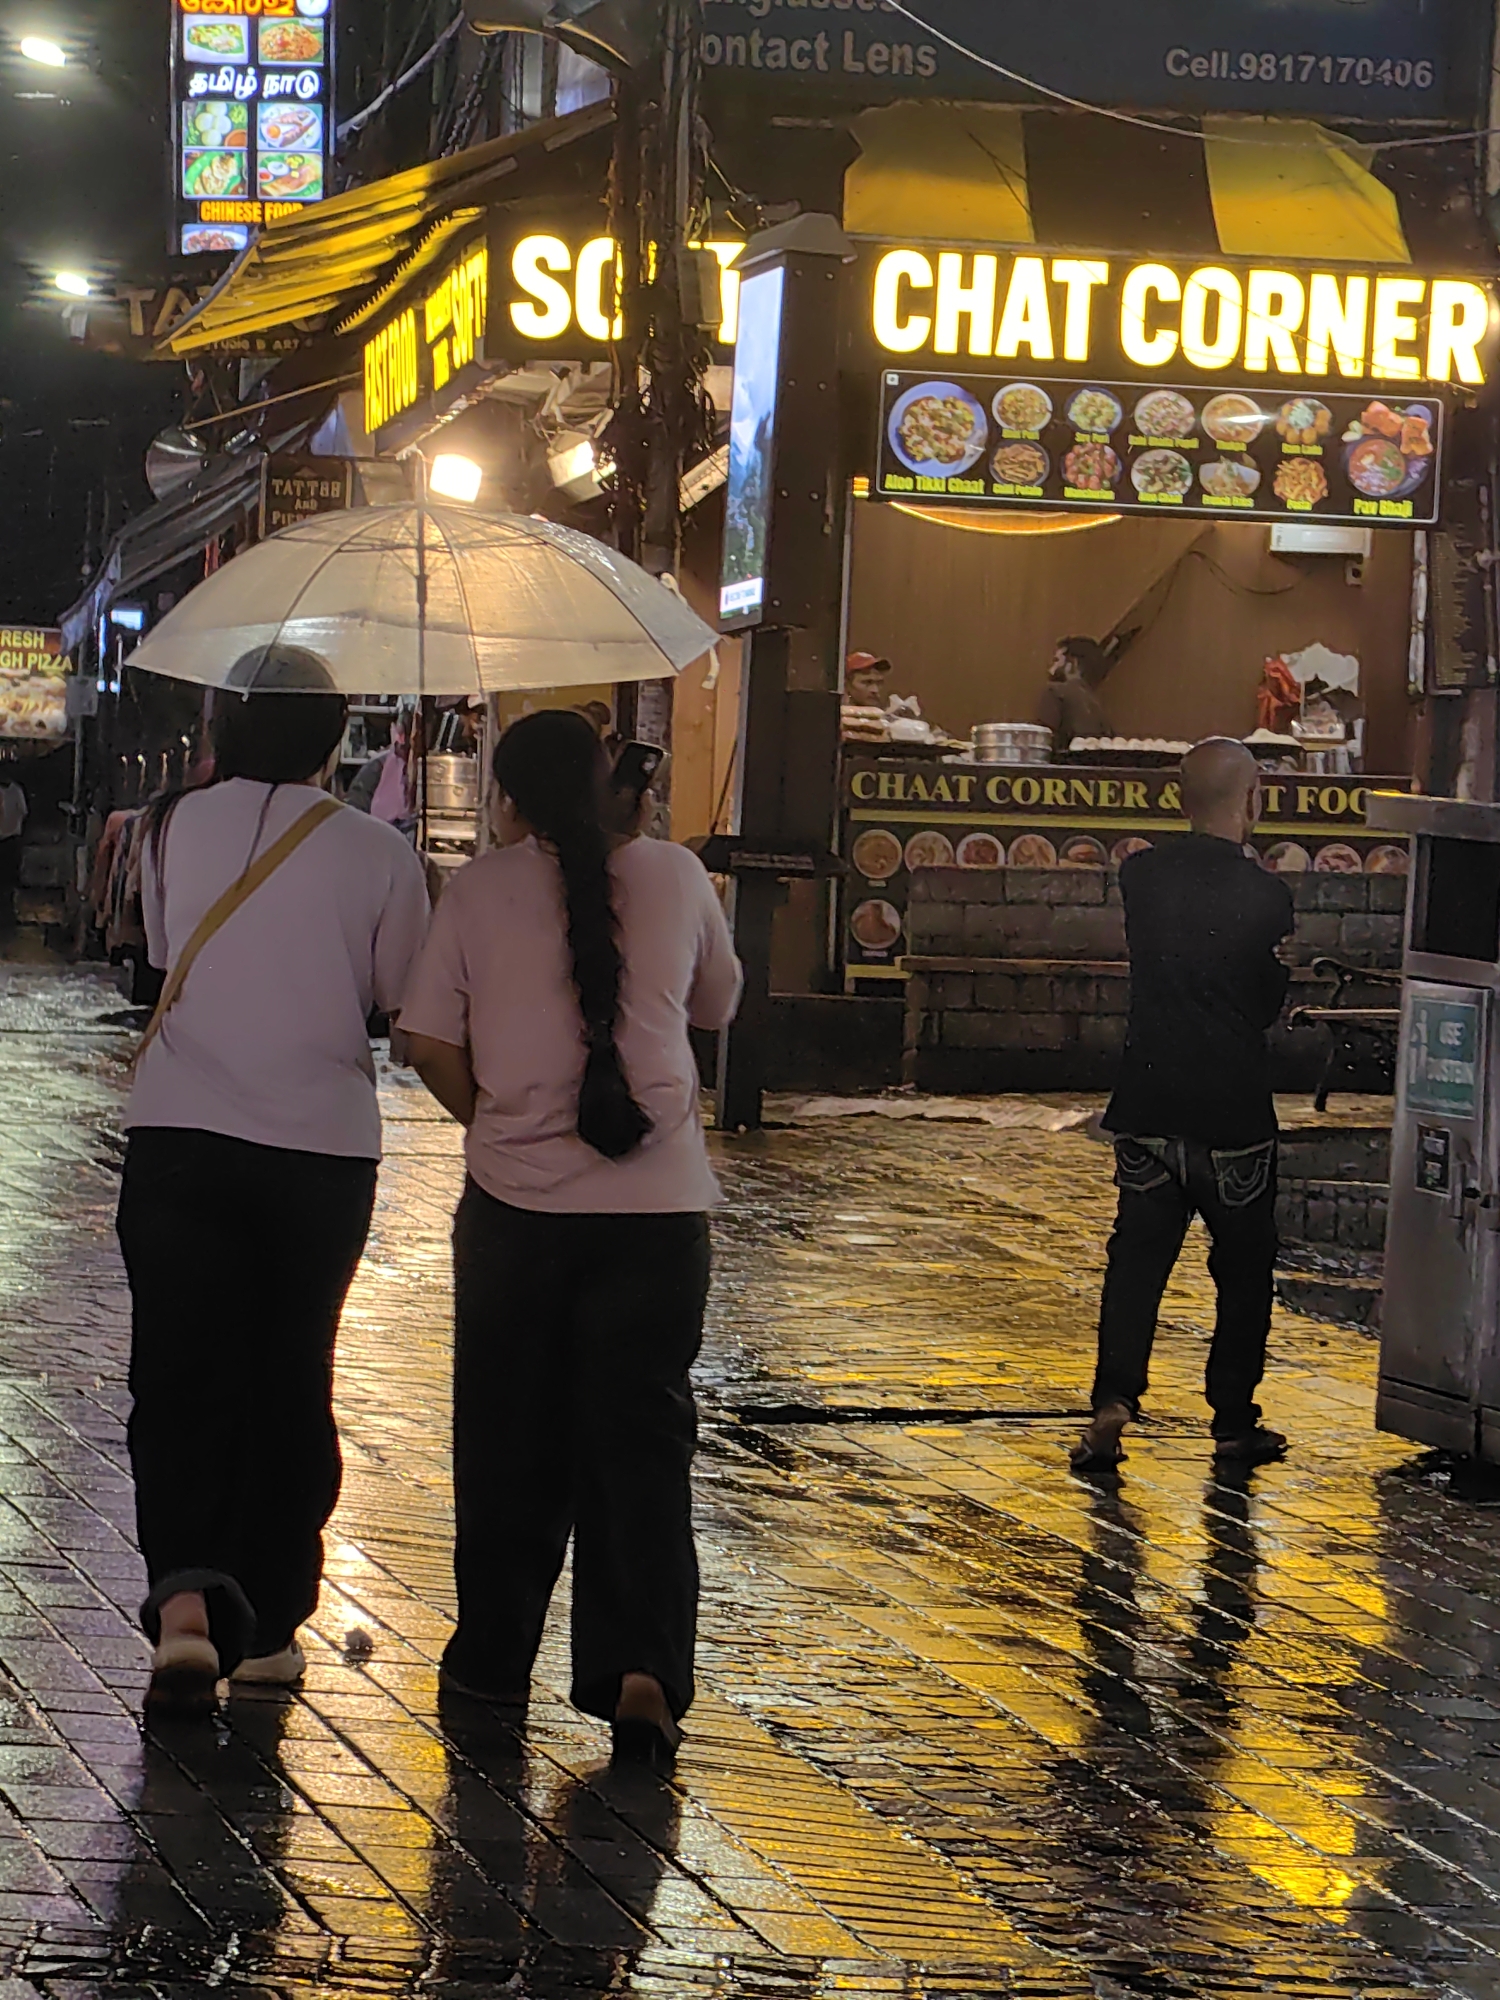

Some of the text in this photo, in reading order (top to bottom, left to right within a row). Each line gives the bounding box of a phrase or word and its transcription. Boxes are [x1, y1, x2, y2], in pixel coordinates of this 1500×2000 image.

[700, 27, 937, 77] ontact Lens
[189, 66, 320, 100] தமிழ் நாடு
[201, 201, 263, 224] CHINESE
[872, 249, 1490, 385] CHAT CORNER
[884, 473, 985, 495] Aloo Tikki Chaat
[1353, 498, 1413, 518] Pav Bhaji
[0, 629, 45, 650] RESH
[0, 650, 73, 672] GH PIZZA
[851, 771, 1181, 810] CHAAT CORNER &
[1295, 785, 1368, 816] FOO
